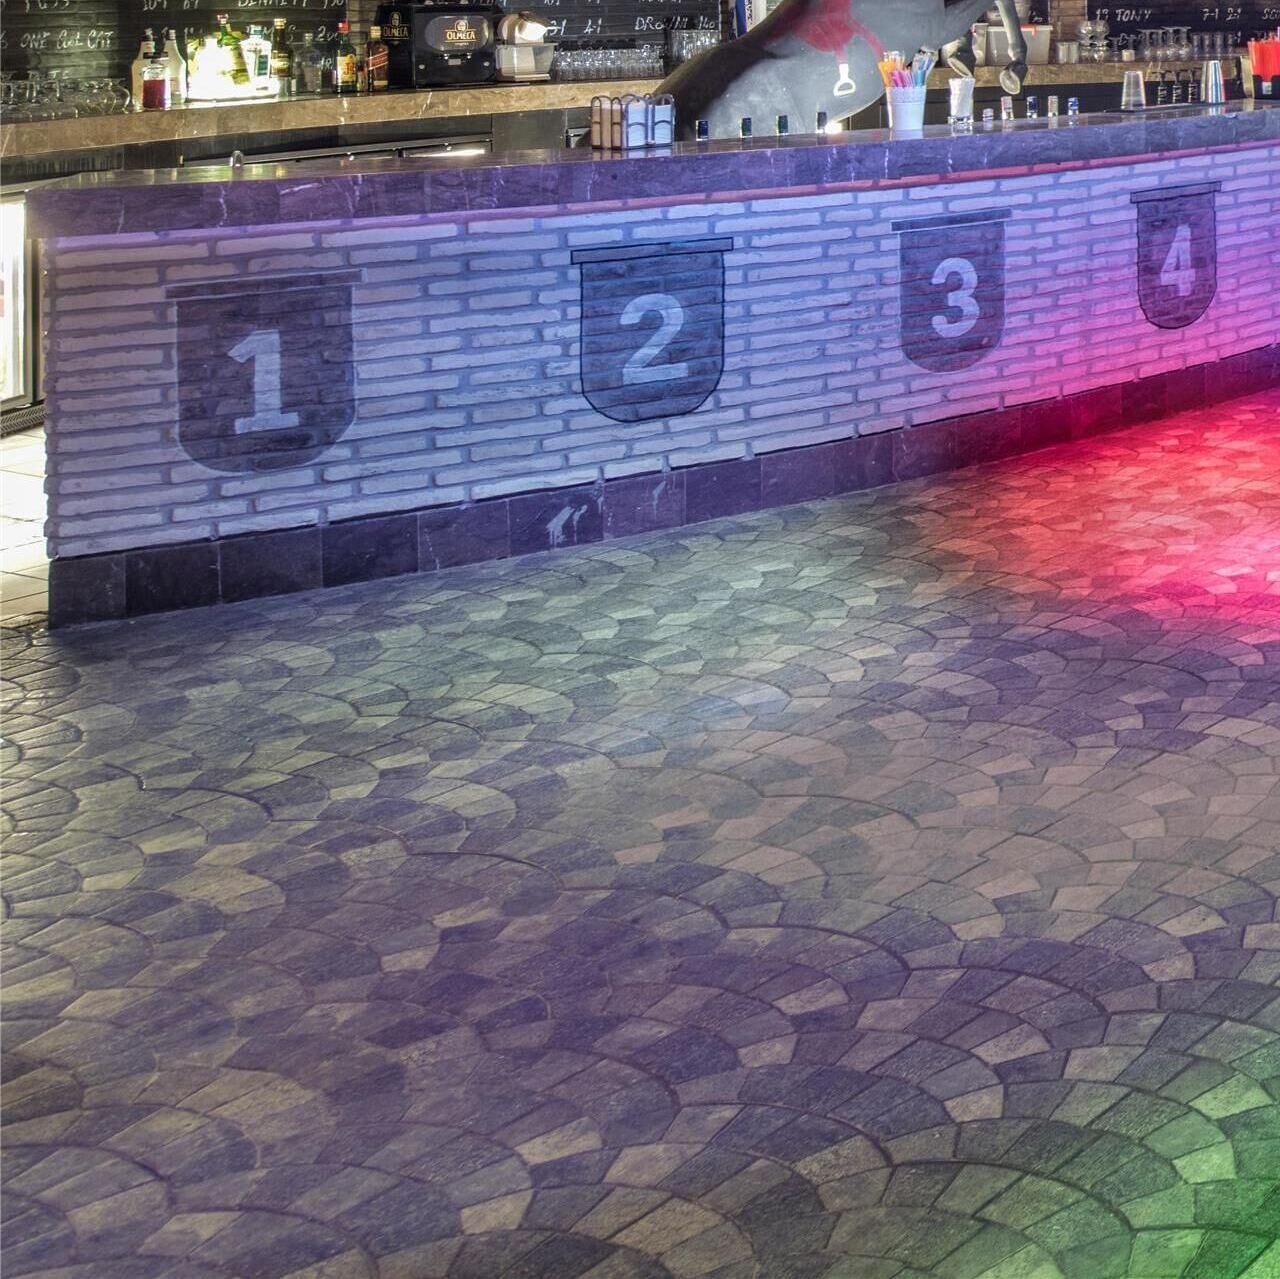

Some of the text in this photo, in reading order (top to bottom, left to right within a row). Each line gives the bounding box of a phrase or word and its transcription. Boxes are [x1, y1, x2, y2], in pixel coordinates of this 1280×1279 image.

[383, 26, 409, 37] OLMECA
[446, 31, 476, 40] OLMECA
[1116, 8, 1151, 22] TONY
[87, 29, 114, 50] CAT
[1160, 224, 1196, 297] 4
[930, 257, 980, 338] 3
[619, 293, 689, 384] 2
[226, 329, 300, 434] 1
